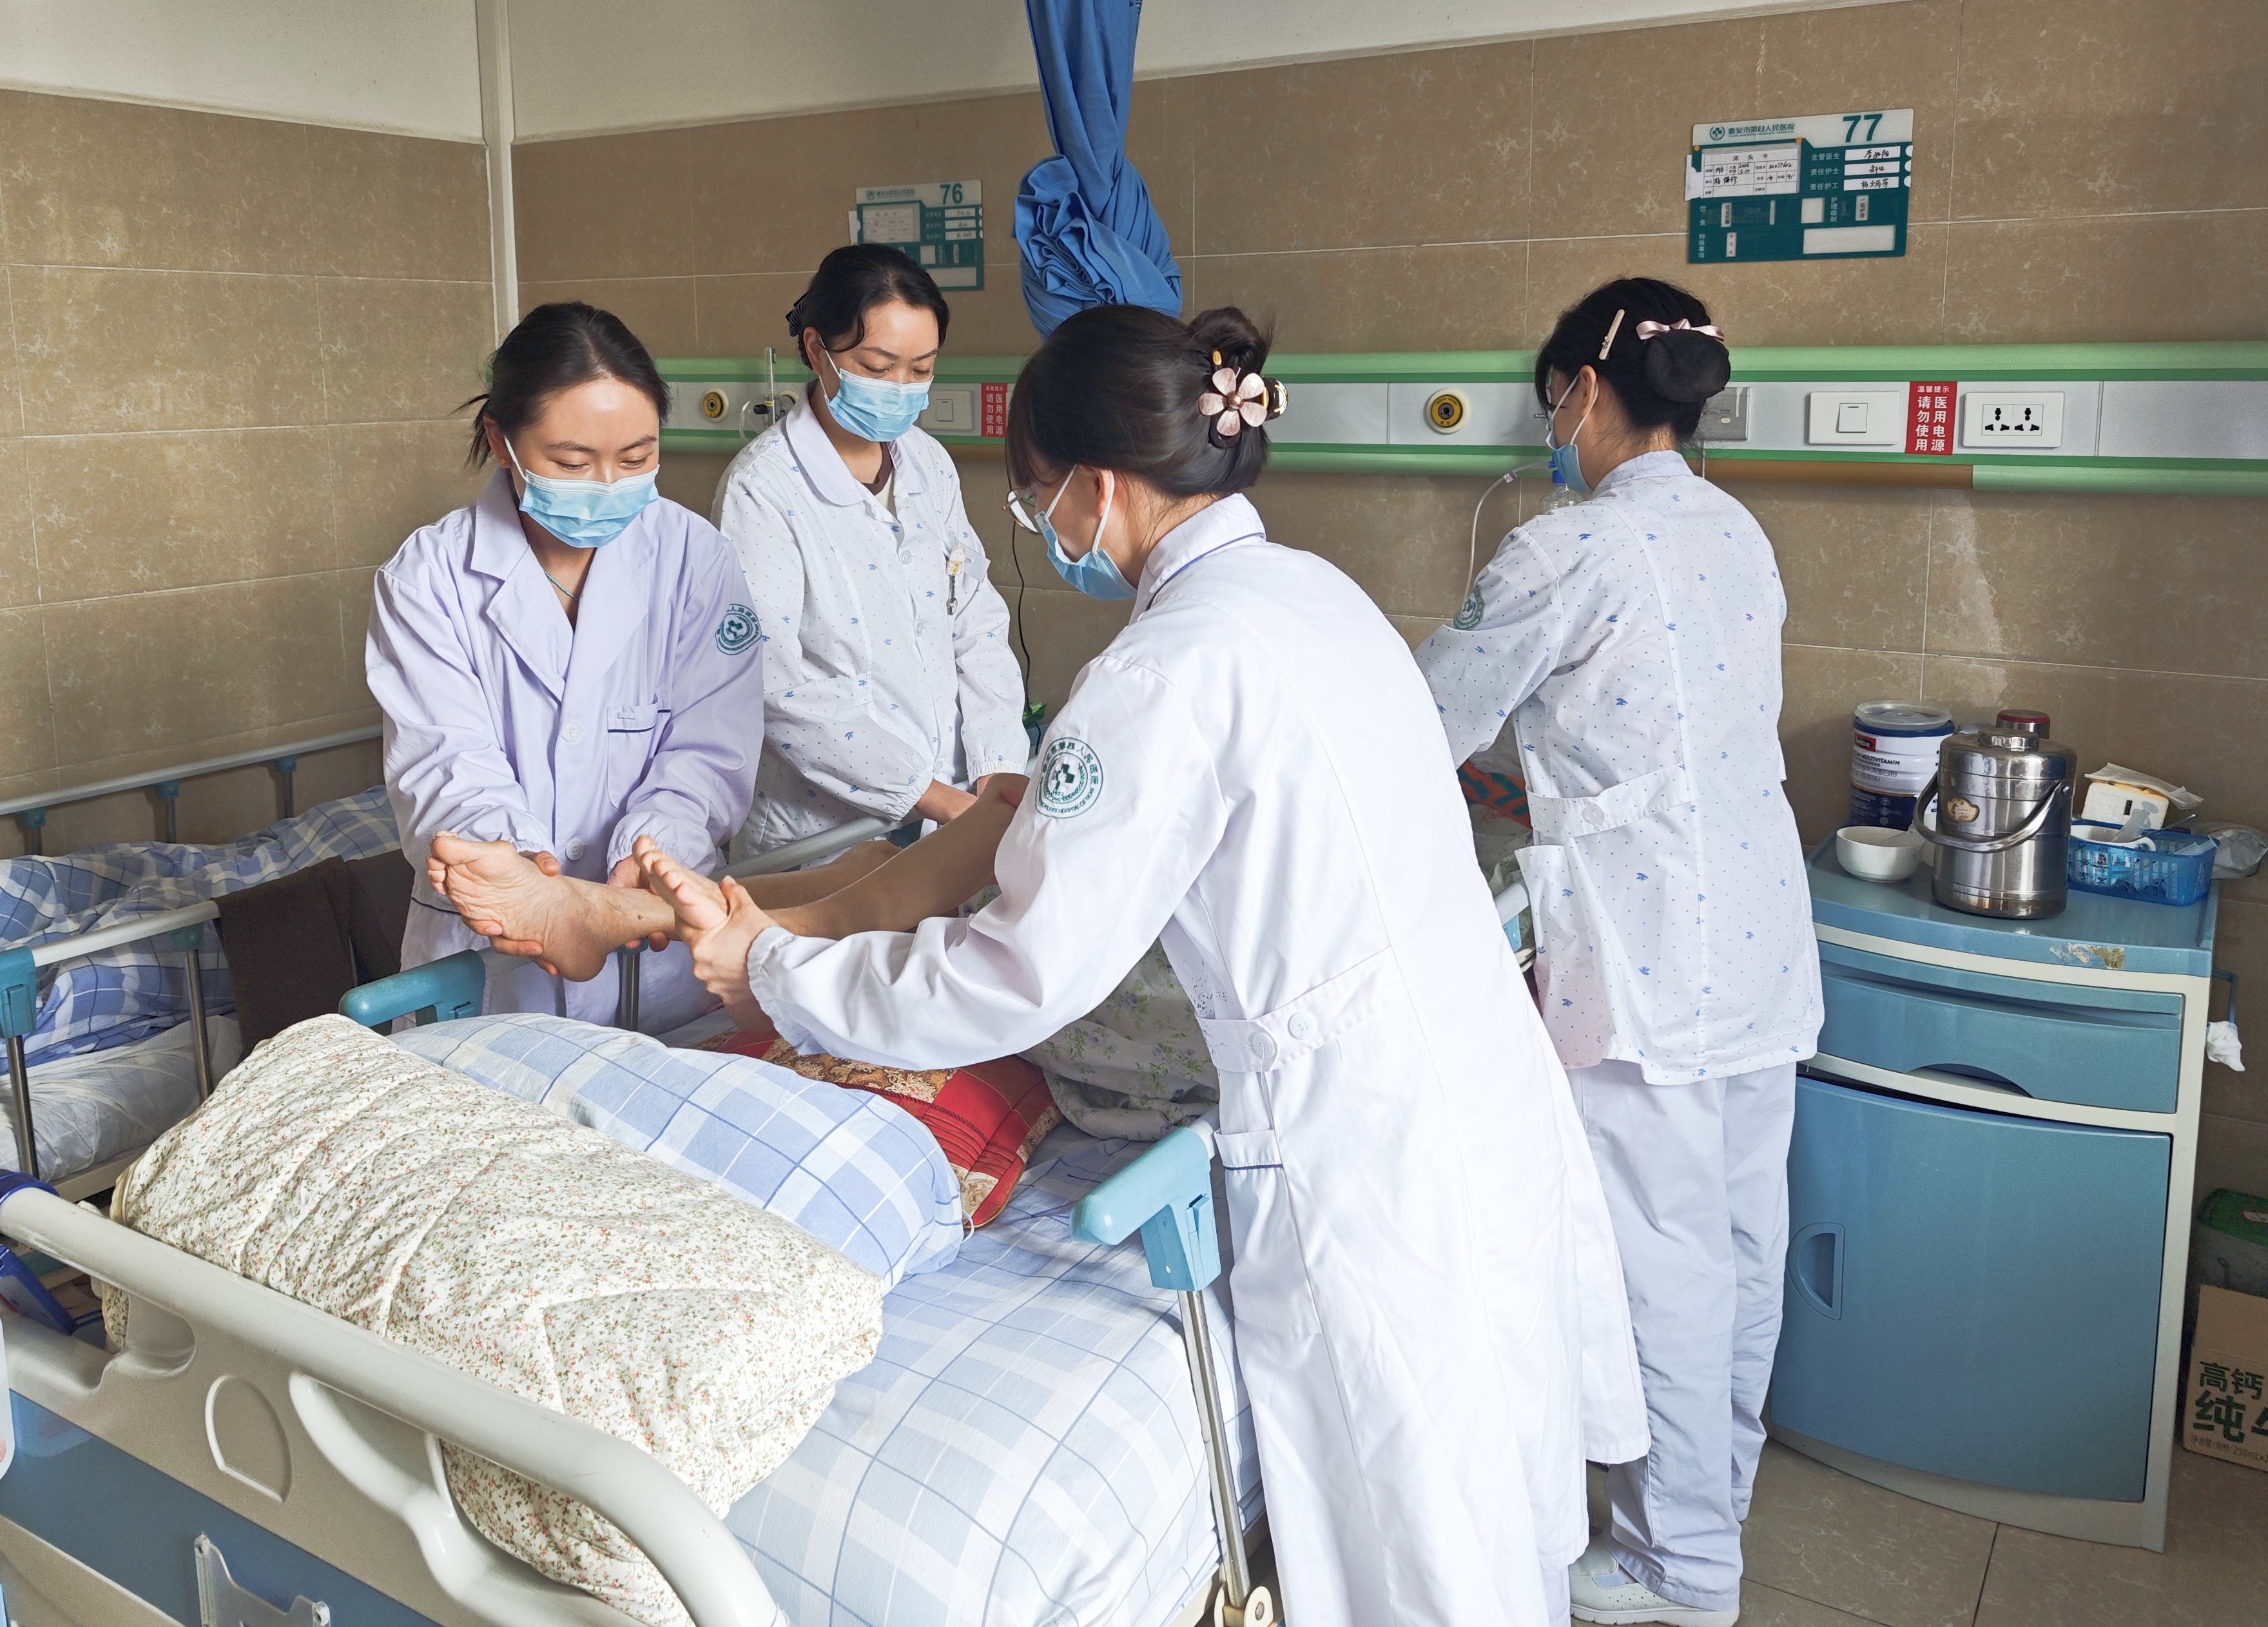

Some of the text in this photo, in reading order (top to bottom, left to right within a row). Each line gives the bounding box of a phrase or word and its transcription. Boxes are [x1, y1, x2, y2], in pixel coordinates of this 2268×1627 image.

[1728, 123, 1795, 135] 雅安市第四人民医院
[1843, 113, 1883, 142] 77
[1811, 153, 1840, 161] 主管医生
[1810, 168, 1840, 176] 责任护士
[940, 183, 963, 205] 76
[1810, 182, 1839, 191] 责任护工
[995, 394, 1003, 435] 医用电源
[1915, 396, 1932, 451] 请勿使用
[1931, 396, 1948, 452] 医用电源
[1861, 754, 1900, 765] MULTIVITAMIN
[2200, 1361, 2264, 1400] 高钙
